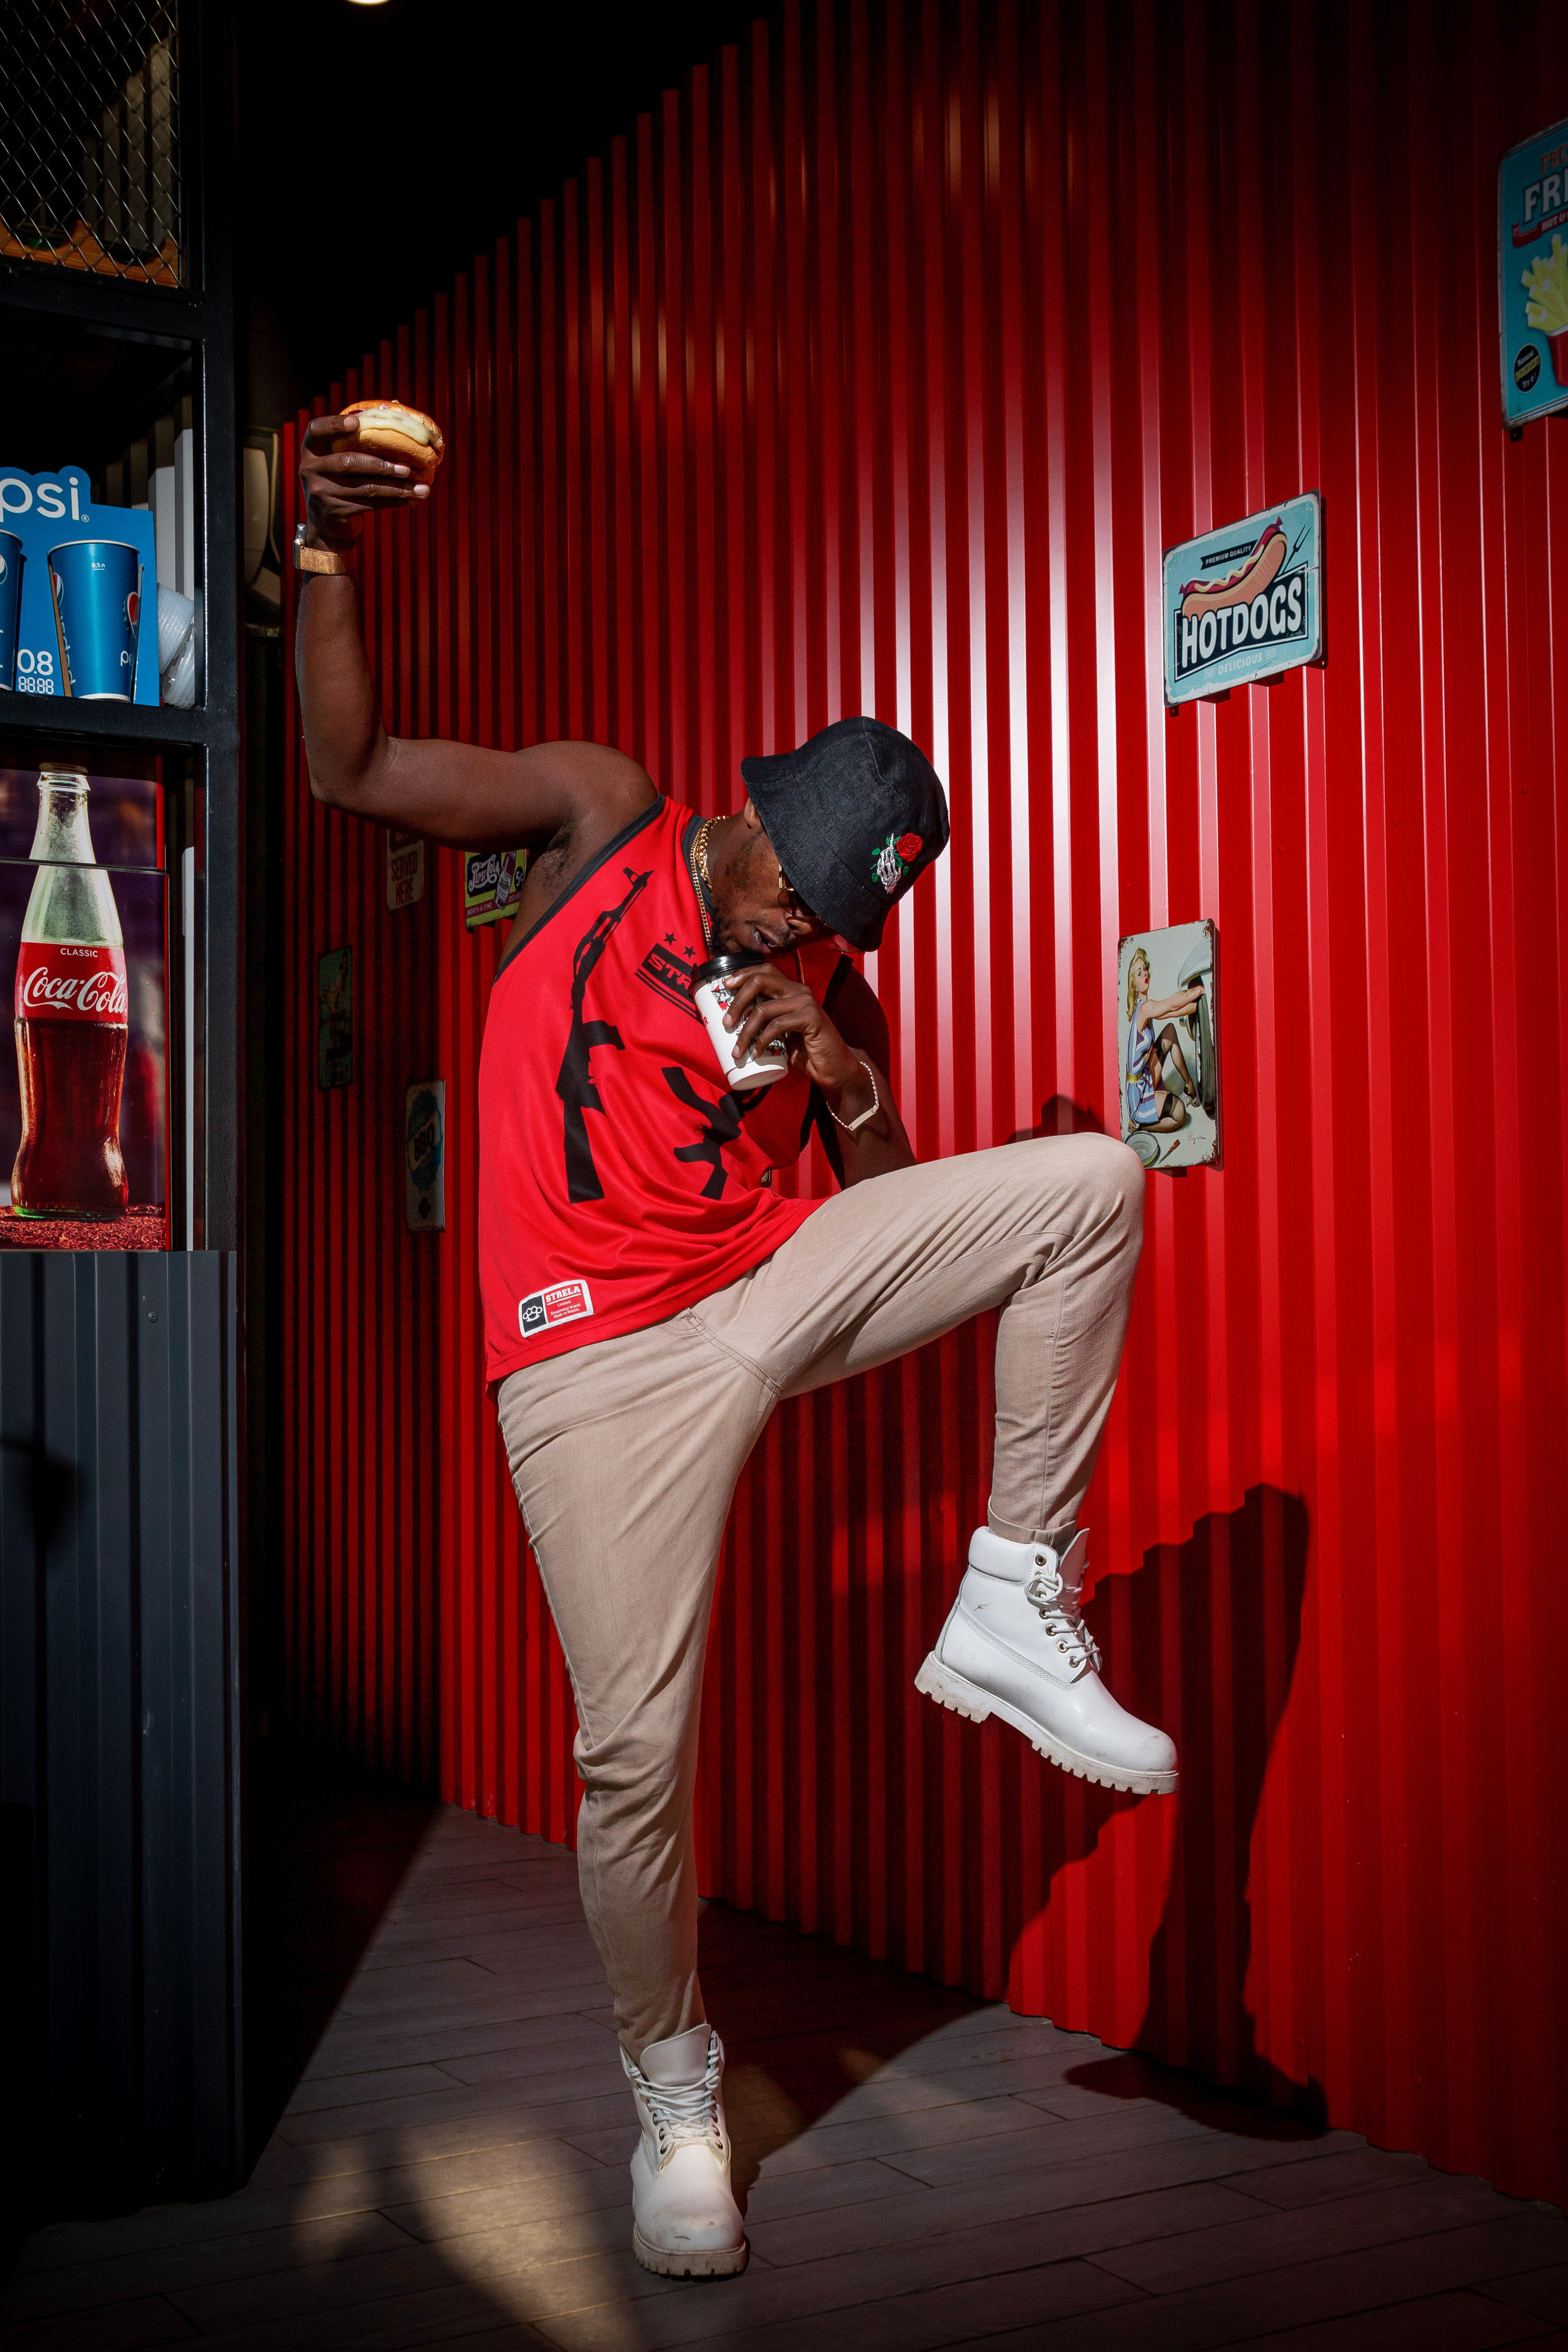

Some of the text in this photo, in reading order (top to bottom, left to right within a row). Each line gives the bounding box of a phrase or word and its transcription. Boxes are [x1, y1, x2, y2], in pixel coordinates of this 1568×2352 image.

[1205, 545, 1252, 565] PREMIUM QUALITY
[1182, 576, 1303, 668] HOTDOGS
[1218, 652, 1263, 676] DELICIOUS
[18, 676, 54, 695] 88.88
[61, 948, 98, 958] CLASSIC
[23, 967, 127, 1014] Coca-Cola
[415, 1123, 435, 1161] BBQ
[545, 1286, 581, 1303] STRELA
